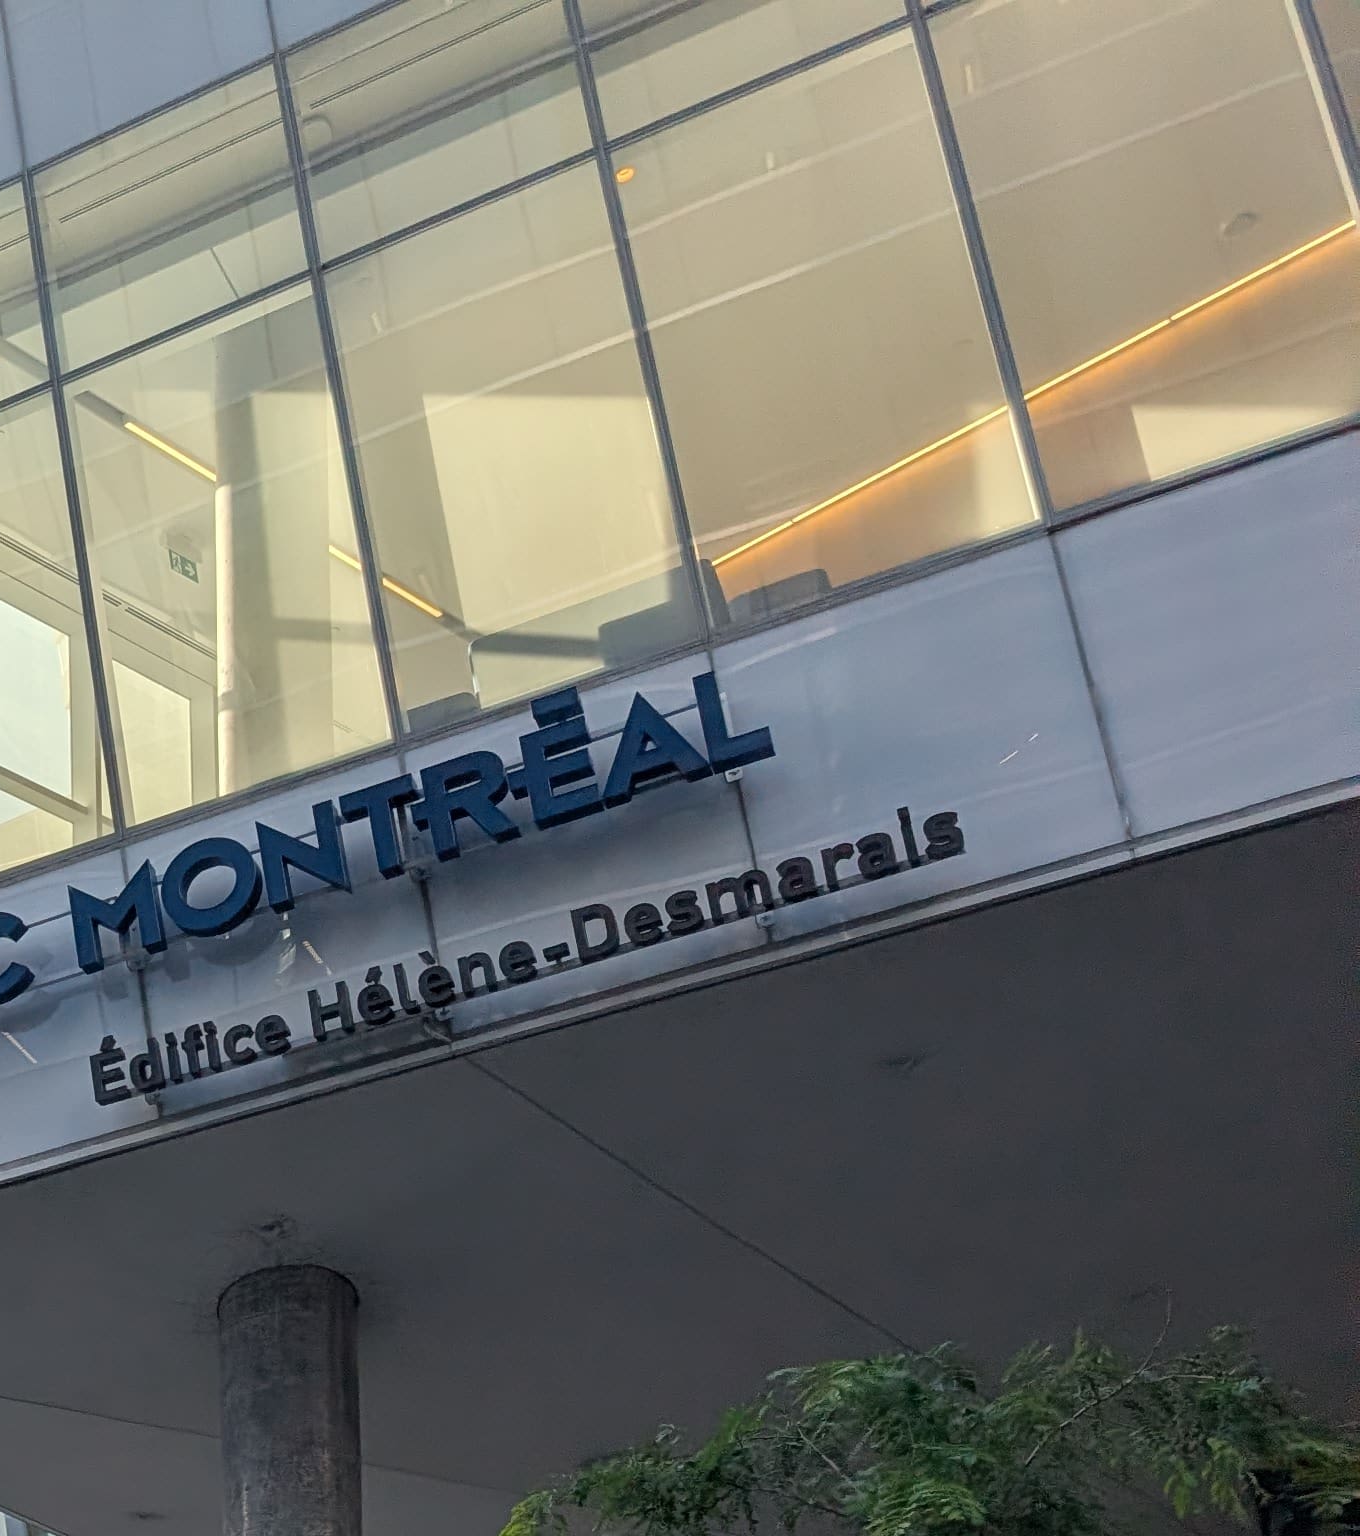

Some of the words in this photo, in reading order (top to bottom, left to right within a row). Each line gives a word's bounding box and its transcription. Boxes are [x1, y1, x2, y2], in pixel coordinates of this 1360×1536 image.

[67, 671, 776, 975] MONTRÉAL
[89, 1013, 292, 1106] Édifice
[307, 806, 965, 1042] Hélène-Desmarais
